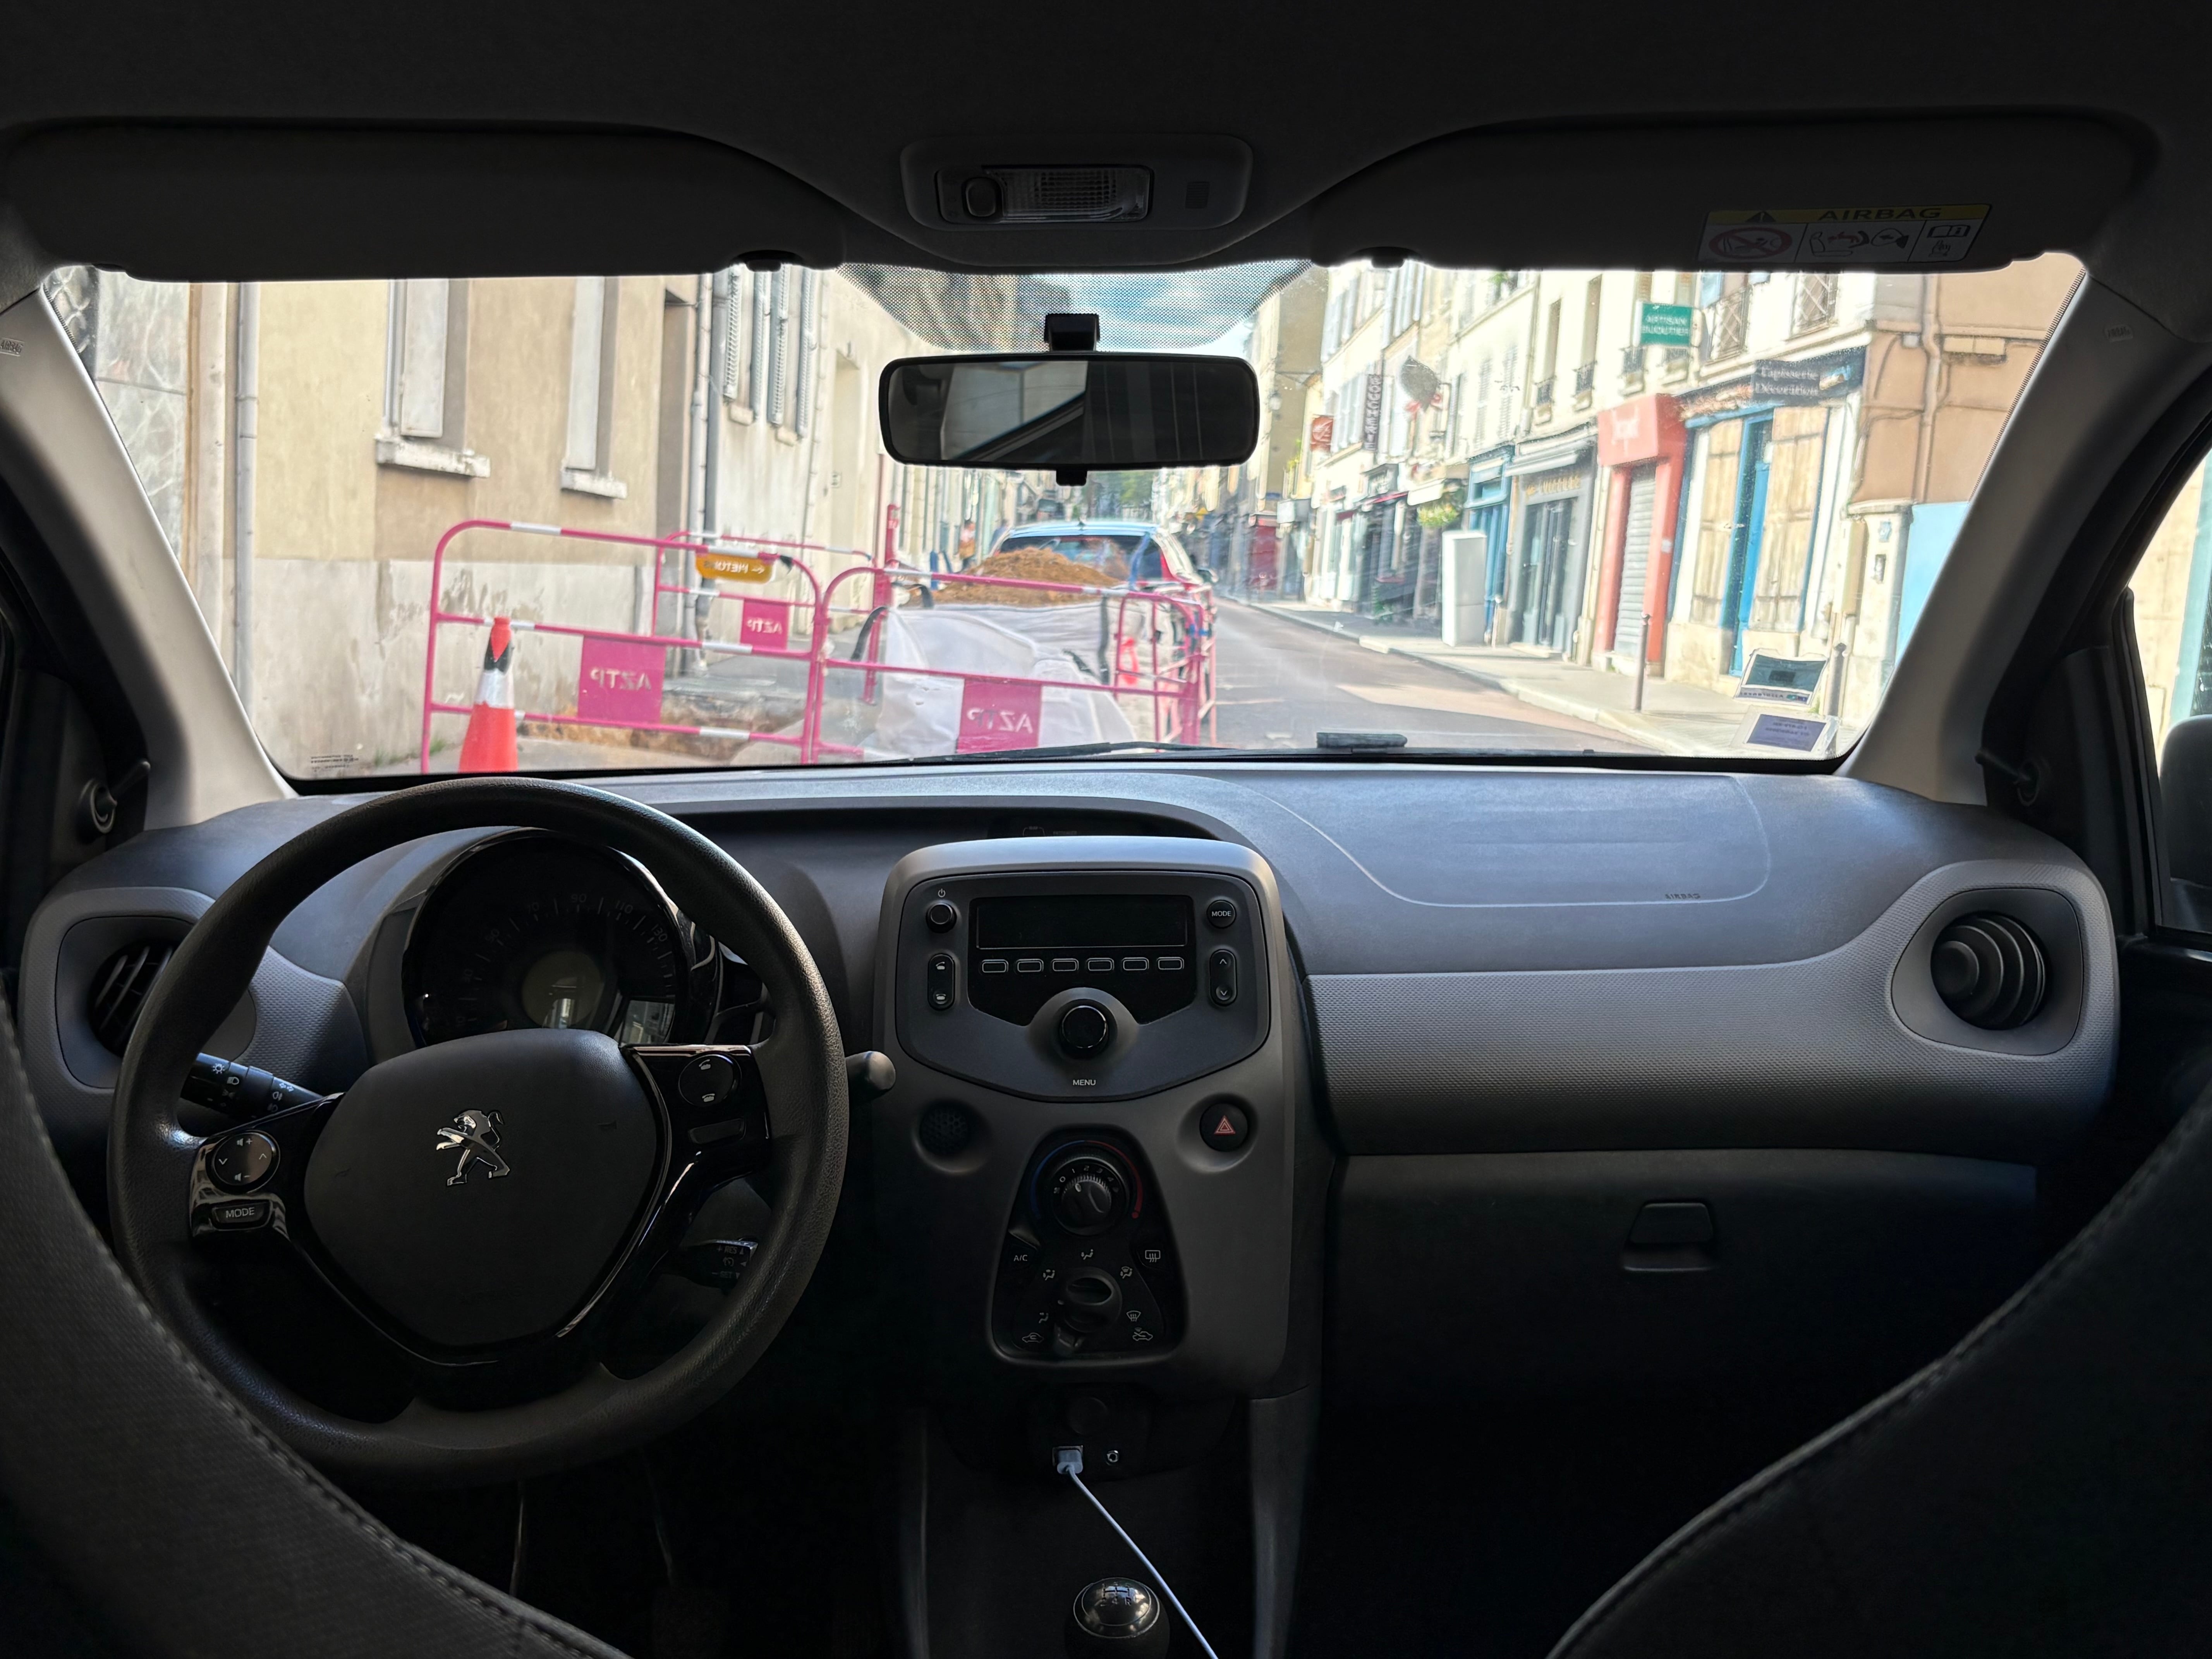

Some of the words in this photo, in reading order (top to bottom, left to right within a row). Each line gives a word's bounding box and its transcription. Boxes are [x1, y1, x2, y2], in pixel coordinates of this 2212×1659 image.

[1818, 208, 1942, 220] AIRBAG
[1645, 314, 1687, 326] ARTISAN
[1364, 376, 1381, 450] BOUCHERIE
[570, 893, 587, 903] 90
[226, 1207, 255, 1218] MODE
[1014, 1254, 1028, 1262] A/C
